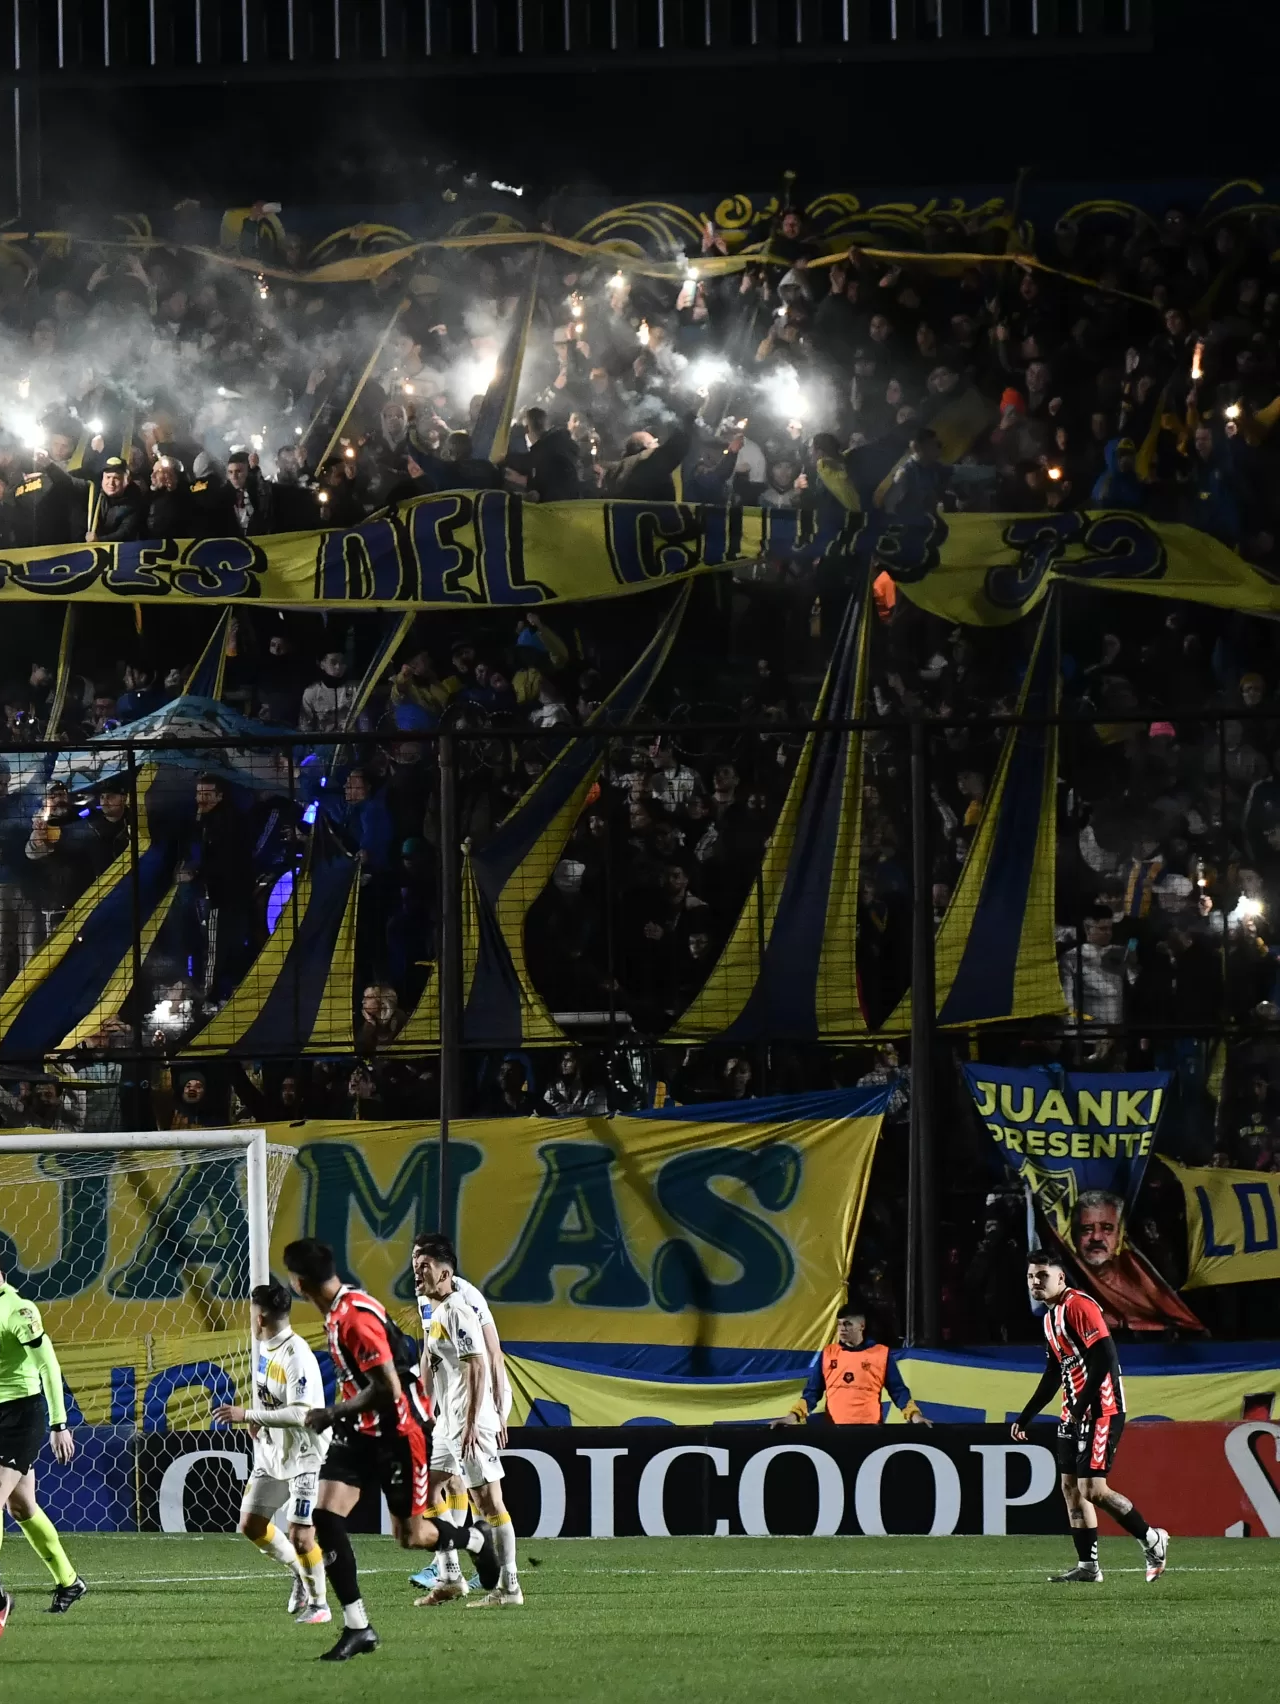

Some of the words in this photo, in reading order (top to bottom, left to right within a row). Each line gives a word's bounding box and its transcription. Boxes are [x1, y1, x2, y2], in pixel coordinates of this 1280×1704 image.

[316, 490, 557, 606] DEL
[974, 1080, 1165, 1126] JUANKI
[991, 1126, 1152, 1159] PRESENTE
[1196, 1181, 1280, 1258] LO
[159, 1446, 1058, 1538] CDICOOP
[389, 1461, 404, 1485] 2
[294, 1498, 311, 1517] 10
